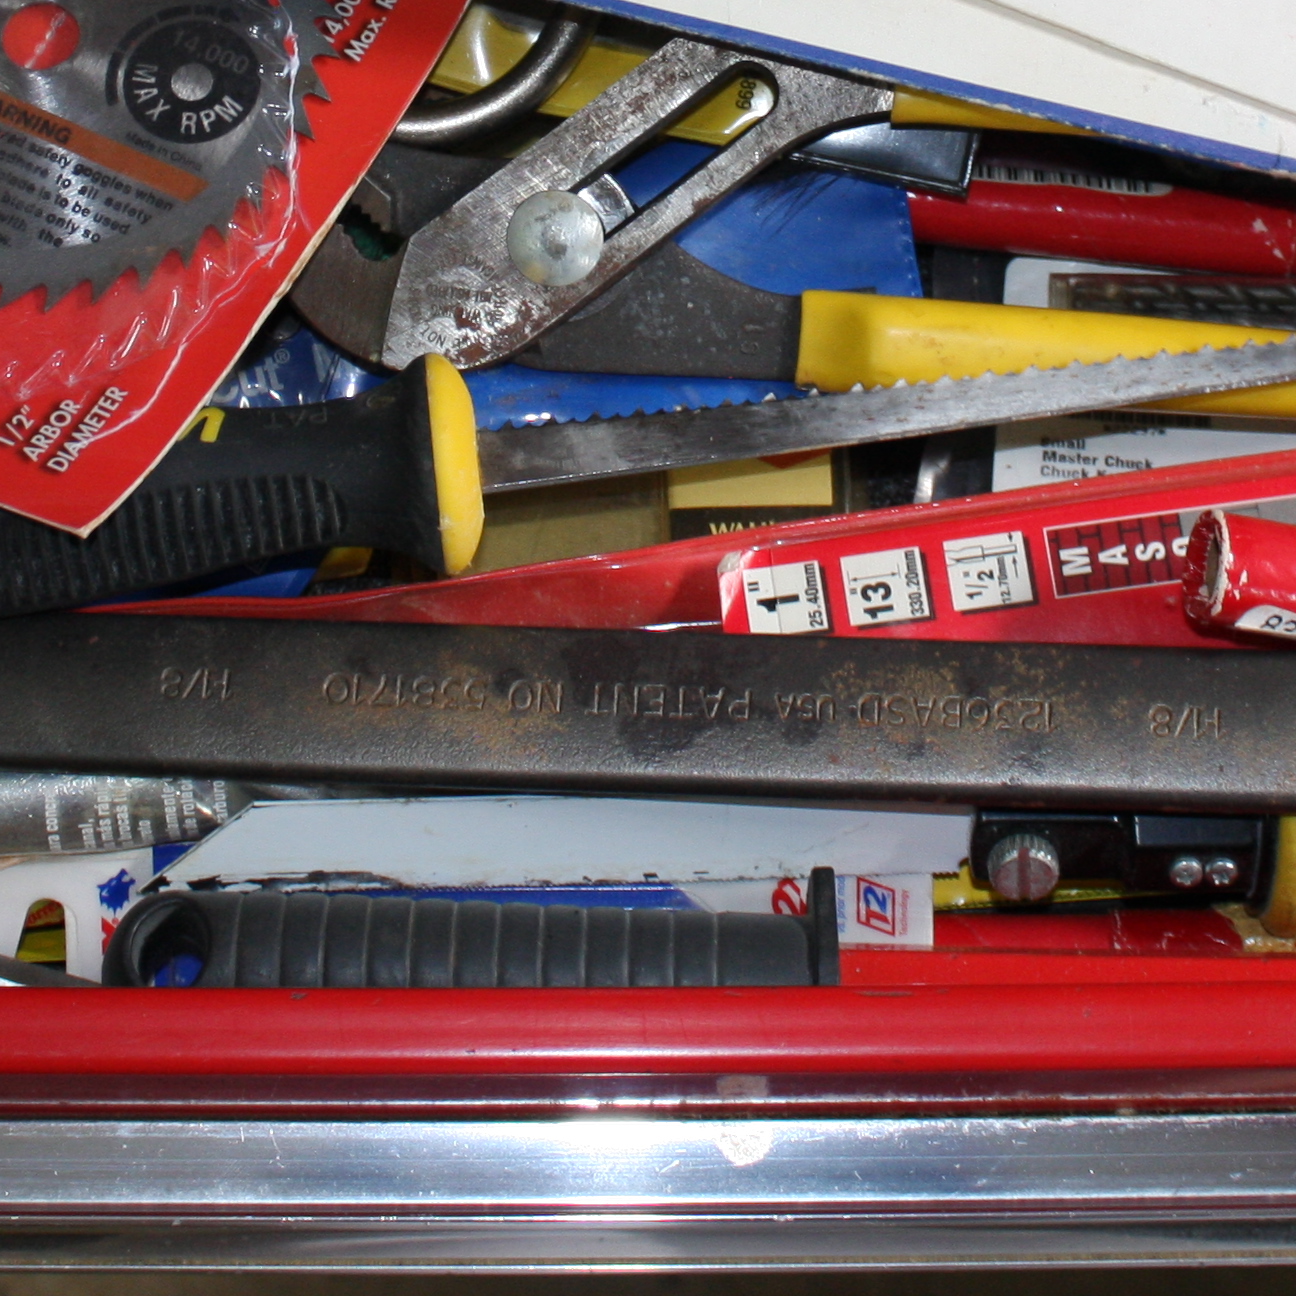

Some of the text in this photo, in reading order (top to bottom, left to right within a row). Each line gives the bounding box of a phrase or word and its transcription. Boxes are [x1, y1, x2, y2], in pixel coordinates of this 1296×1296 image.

[345, 9, 385, 61] Max.
[135, 61, 169, 123] MAX
[179, 98, 242, 136] RPM
[72, 162, 174, 212] goggles when
[76, 182, 153, 225] all safety
[43, 210, 80, 237] only
[91, 211, 129, 236] used
[21, 393, 82, 464] ARBOR
[46, 379, 129, 477] DIAMETER
[1042, 450, 1153, 470] Master Chuck
[1058, 533, 1194, 577] MASO
[802, 563, 823, 627] 25.40mm
[902, 549, 924, 615] 330.20mm
[995, 556, 1011, 604] 12.70mm
[507, 678, 564, 713] NO
[585, 684, 751, 722] PATENT
